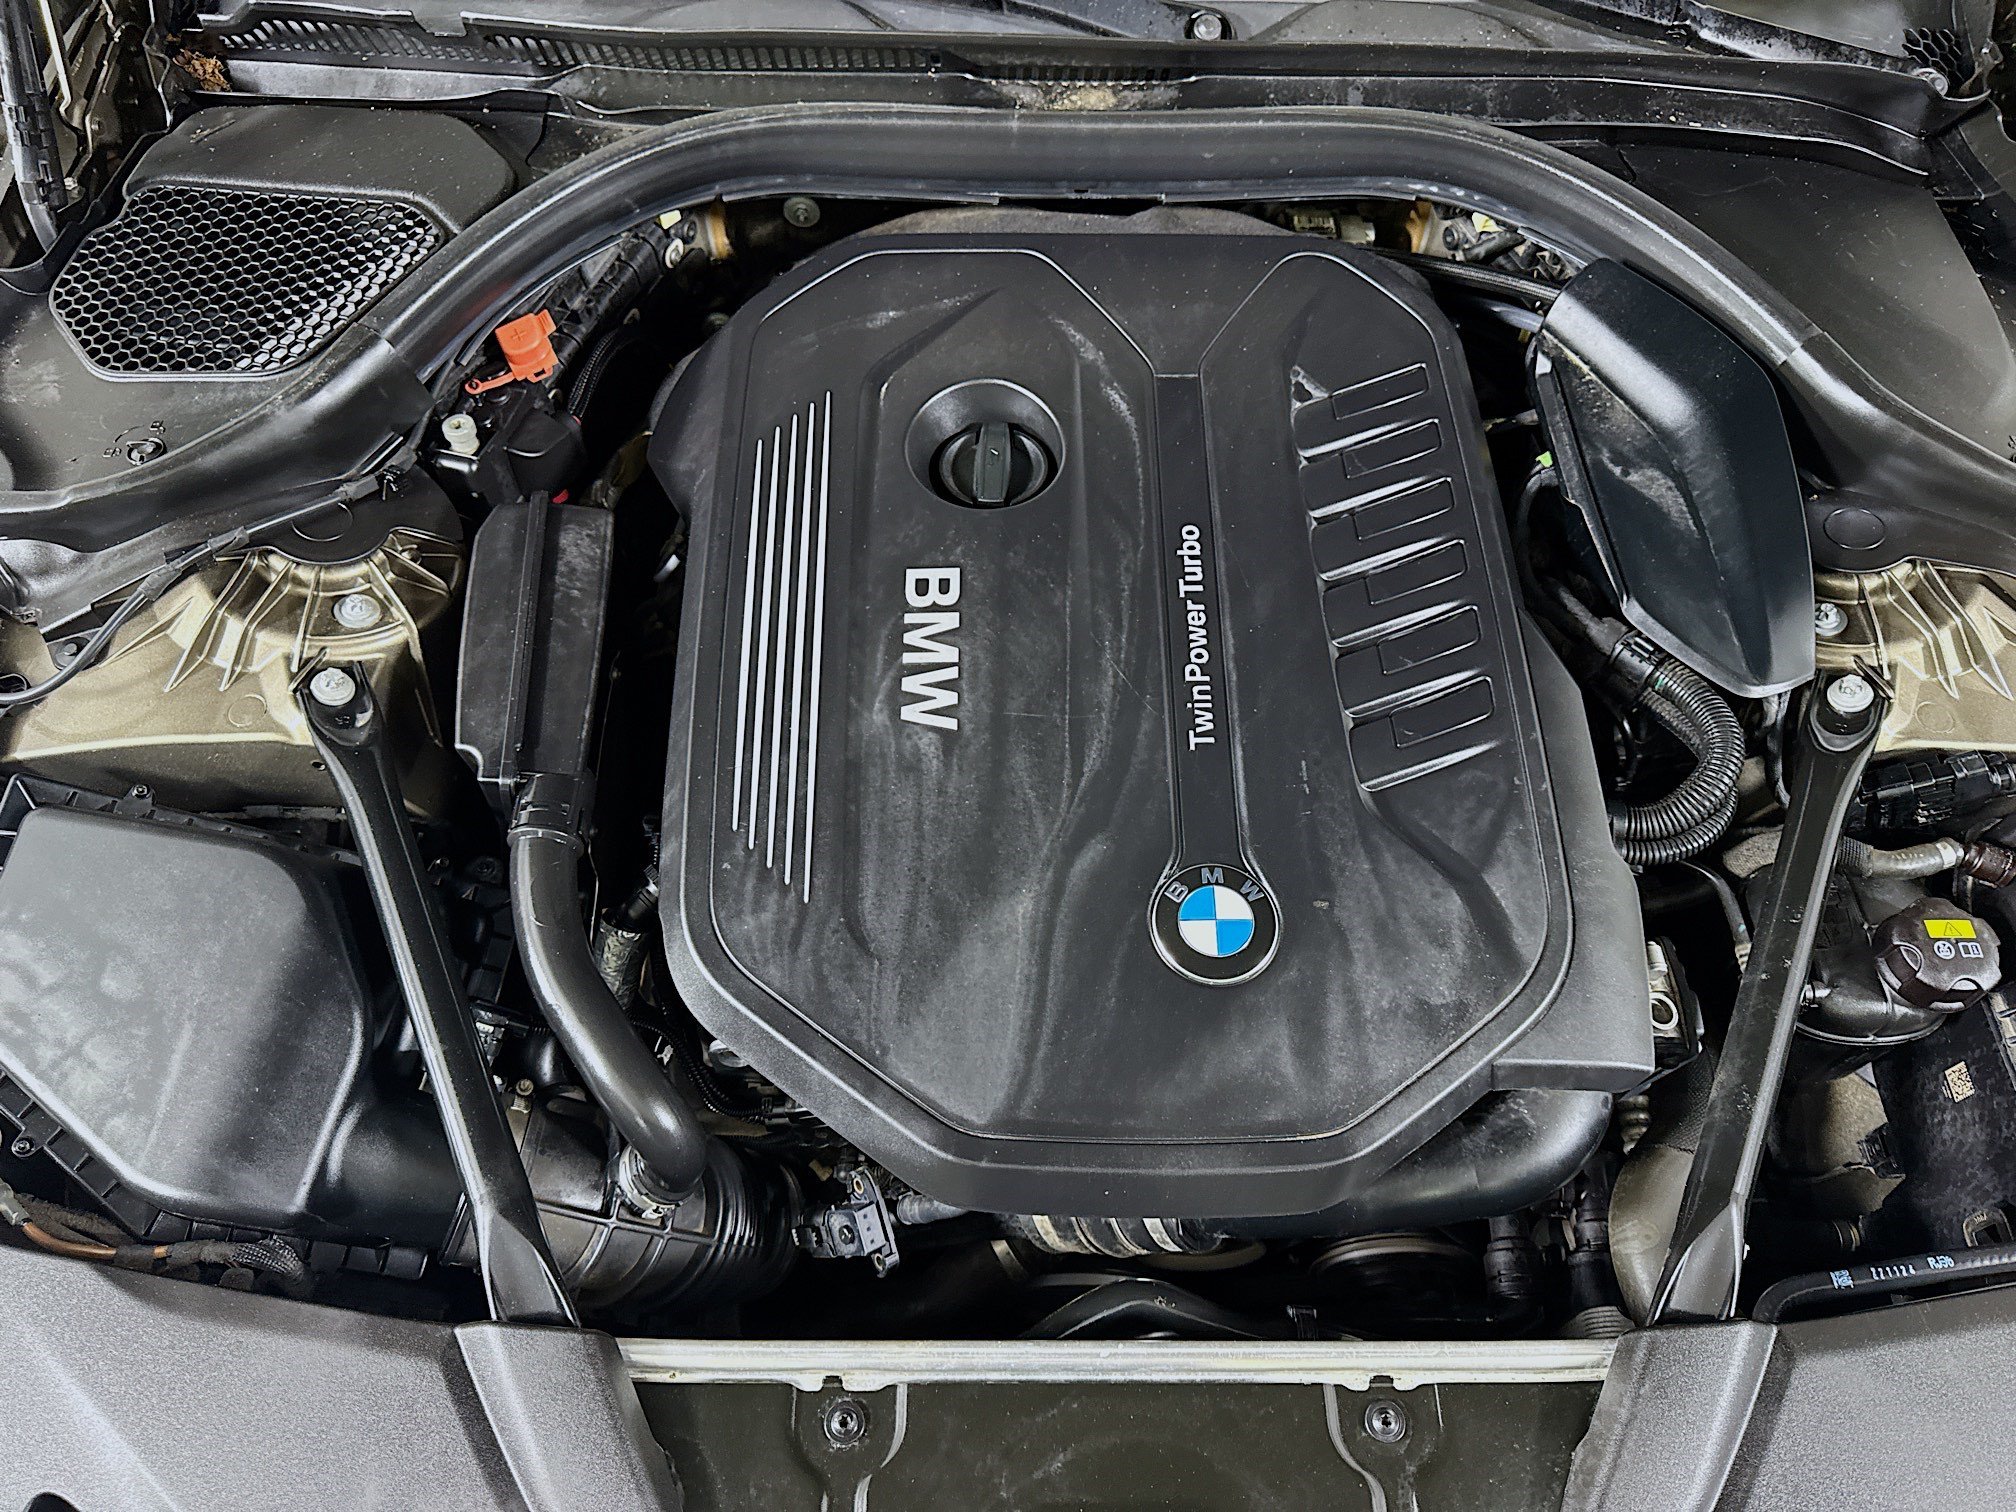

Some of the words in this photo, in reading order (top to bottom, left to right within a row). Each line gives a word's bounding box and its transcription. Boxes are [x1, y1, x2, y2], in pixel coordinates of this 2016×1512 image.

[1176, 523, 1205, 599] Turbo
[899, 566, 961, 732] BMW
[1184, 600, 1217, 751] TwinPower
[1164, 866, 1265, 904] BMW
